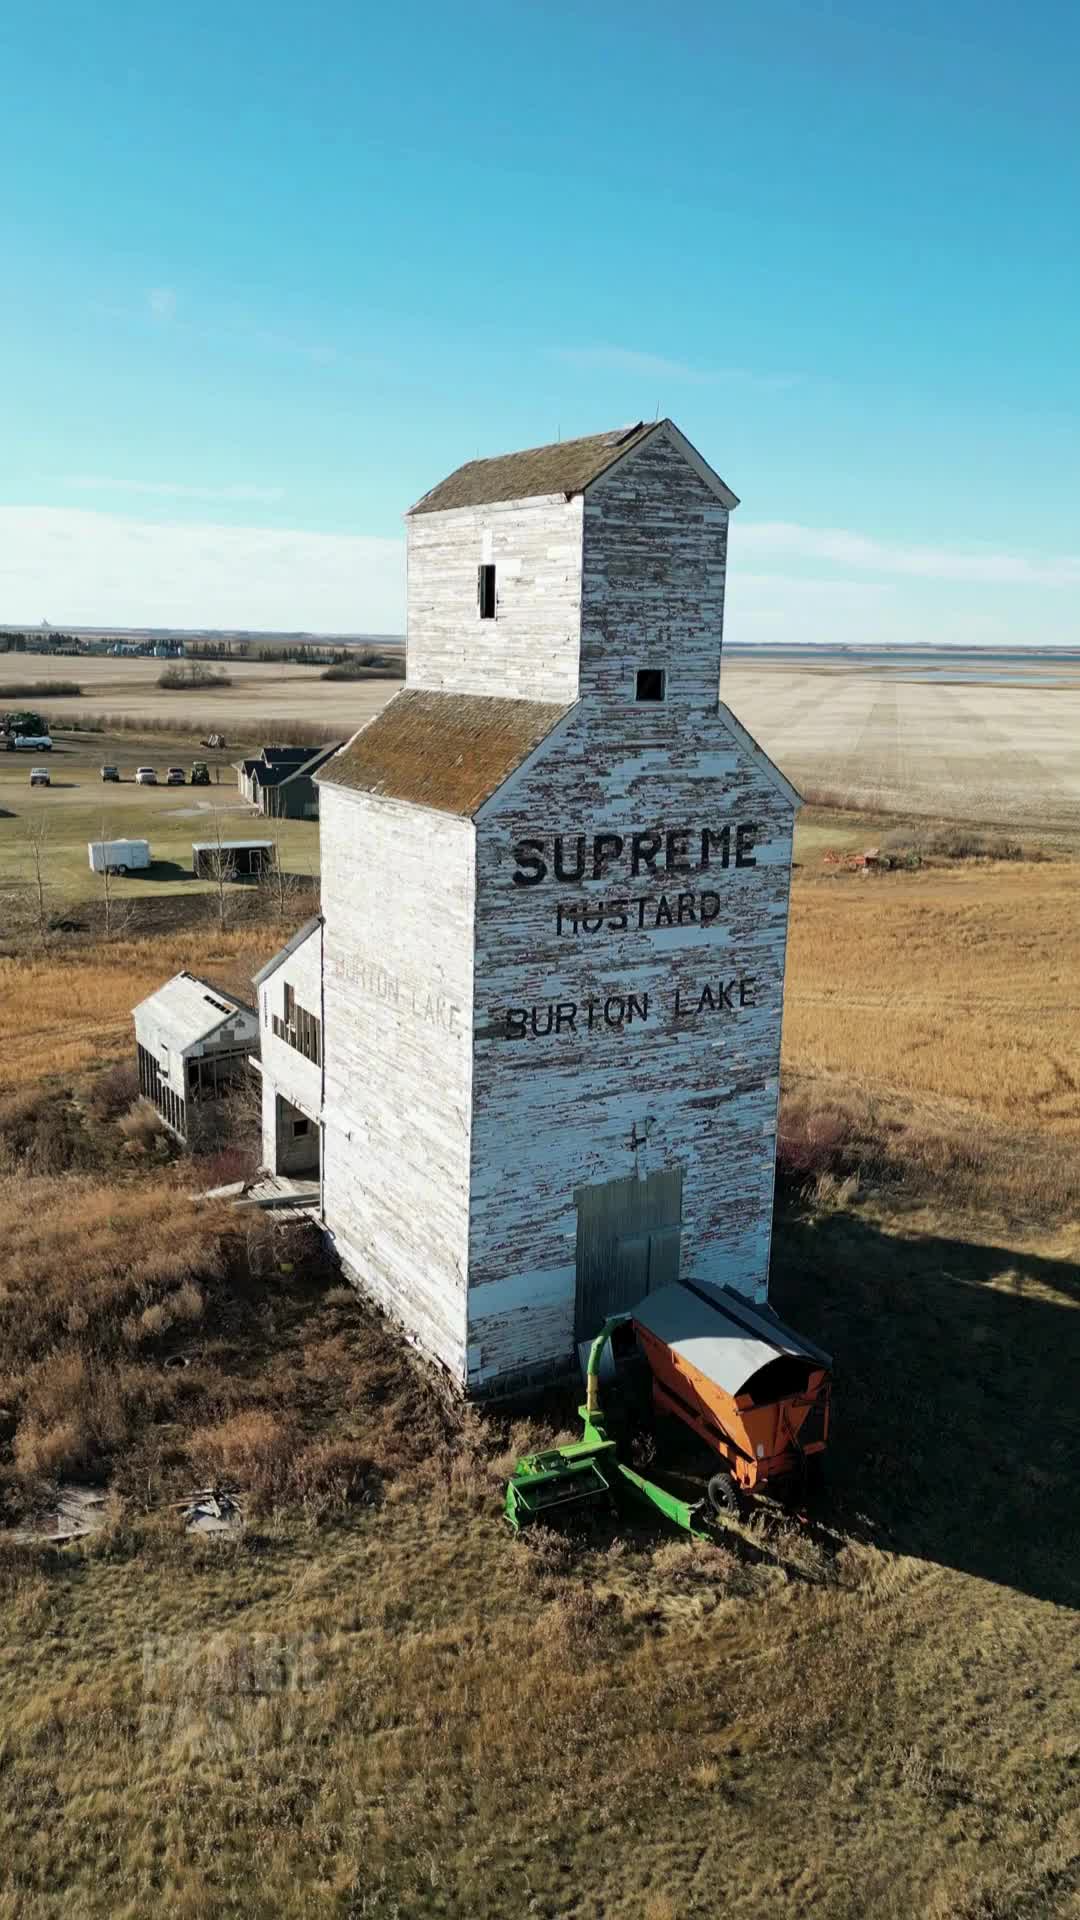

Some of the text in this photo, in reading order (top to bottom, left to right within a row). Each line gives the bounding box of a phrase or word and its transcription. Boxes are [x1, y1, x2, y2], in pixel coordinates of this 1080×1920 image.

[512, 822, 758, 886] SUPREME
[556, 890, 721, 937] MUSTARD
[504, 976, 757, 1041] BURTON LAKE
